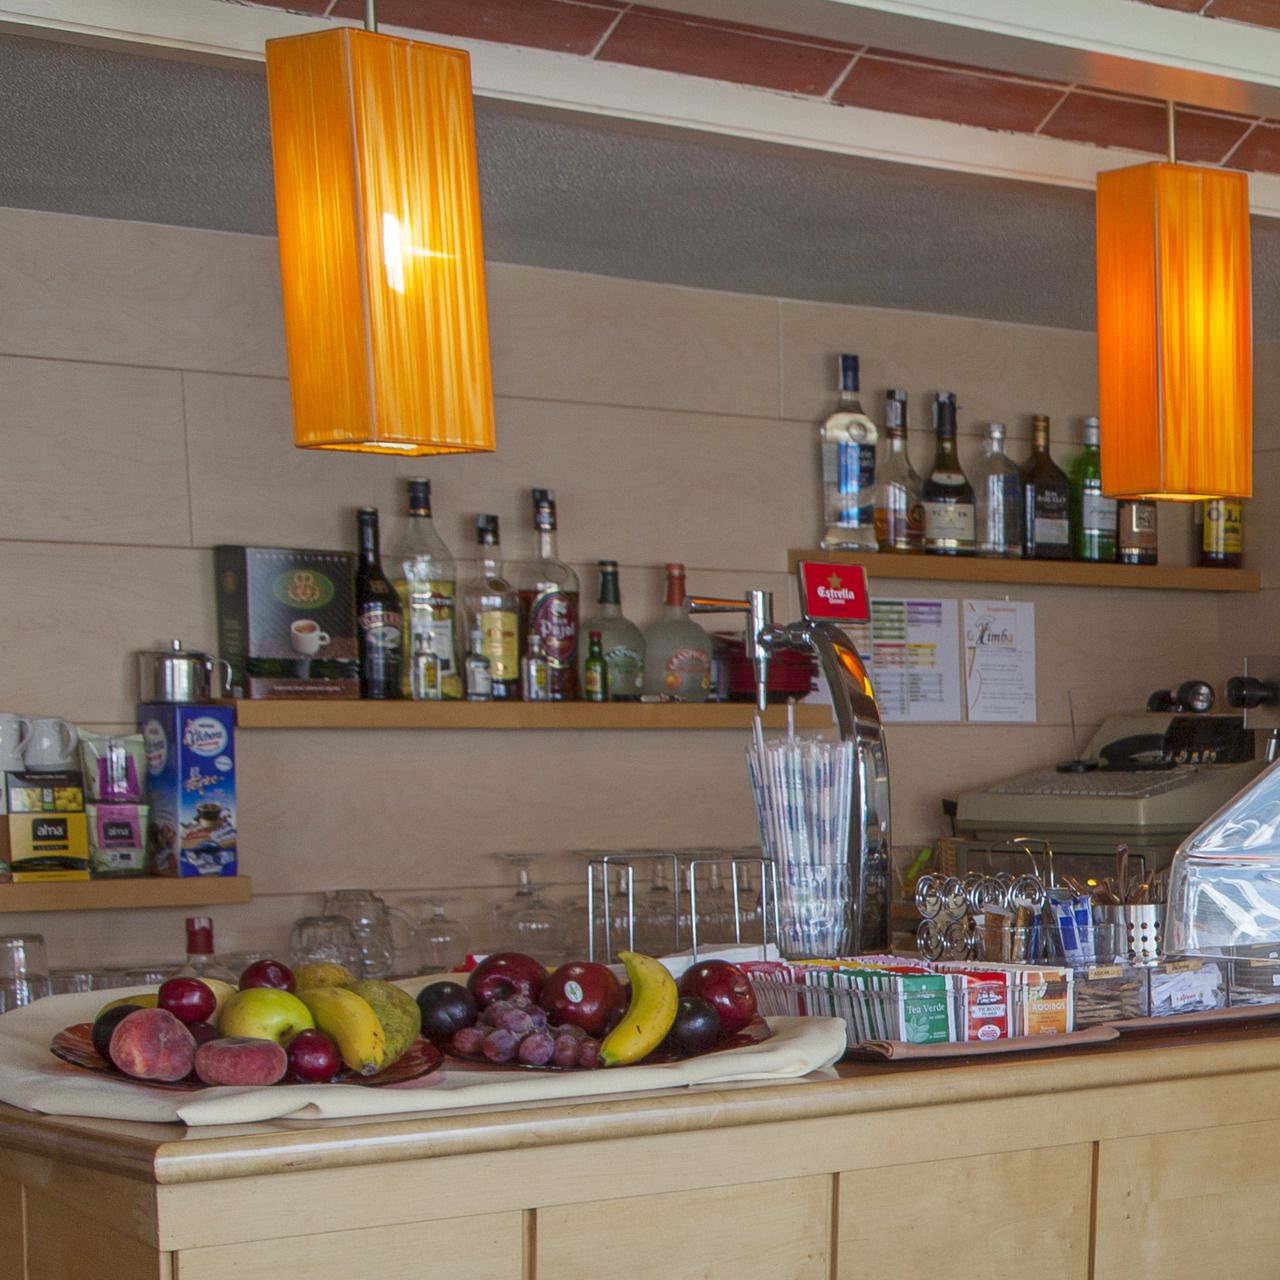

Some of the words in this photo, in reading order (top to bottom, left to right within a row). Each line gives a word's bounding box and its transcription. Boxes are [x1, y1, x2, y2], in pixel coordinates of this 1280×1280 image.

[817, 585, 855, 600] Estrella
[907, 1004, 922, 1014] Tea
[922, 1002, 945, 1013] Verde
[1032, 1002, 1065, 1012] ROOIBOS
